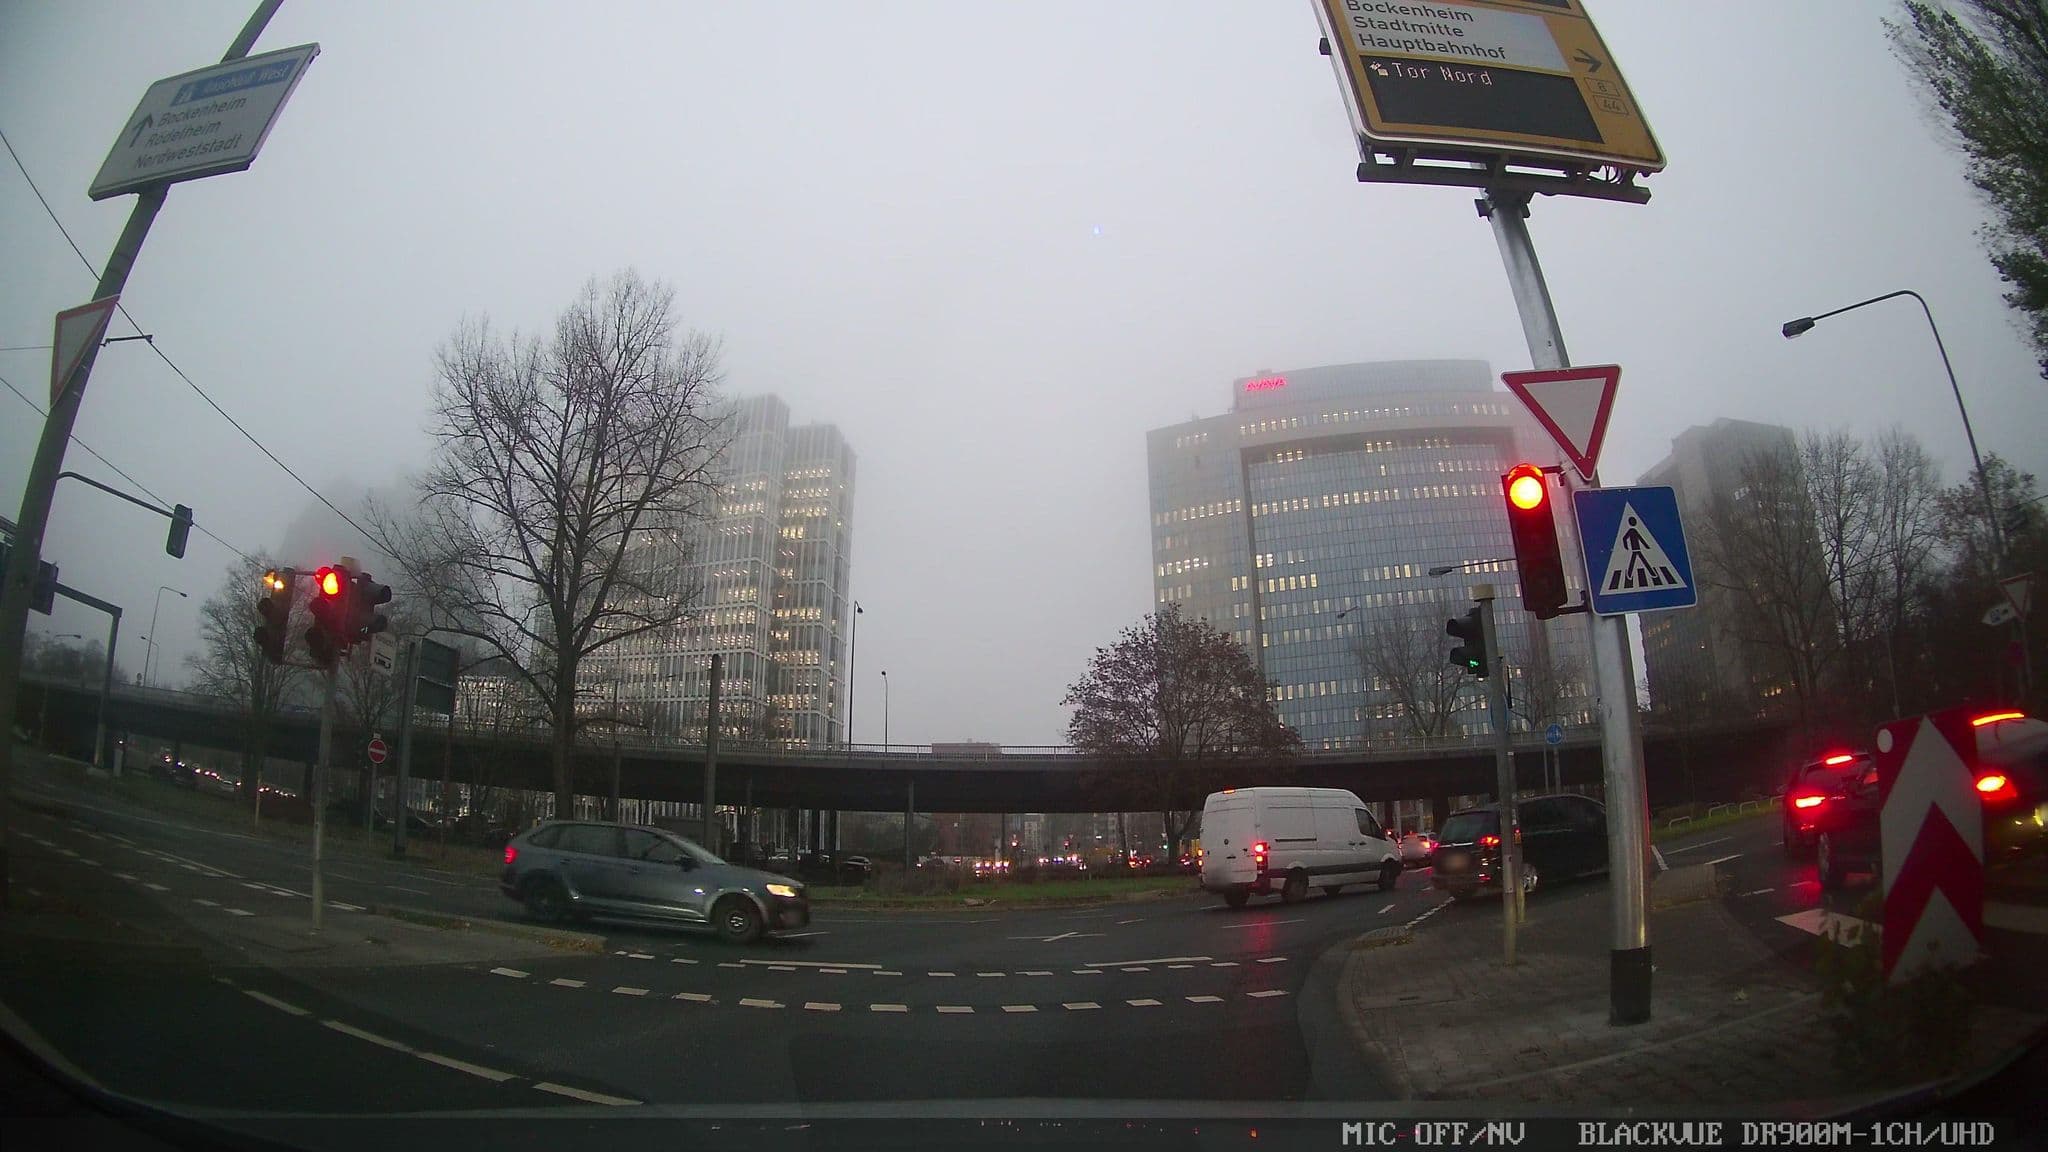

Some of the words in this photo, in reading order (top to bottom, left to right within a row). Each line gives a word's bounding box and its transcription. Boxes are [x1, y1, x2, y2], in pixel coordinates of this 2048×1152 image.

[1347, 0, 1474, 22] Bockenheim
[1353, 16, 1464, 37] Stadtmitte
[1358, 33, 1506, 60] Hauptbahnhof
[1391, 62, 1430, 79] Tor
[1440, 65, 1493, 86] Nord
[158, 98, 246, 127] Bockenheim
[136, 133, 242, 169] Nordweststadt
